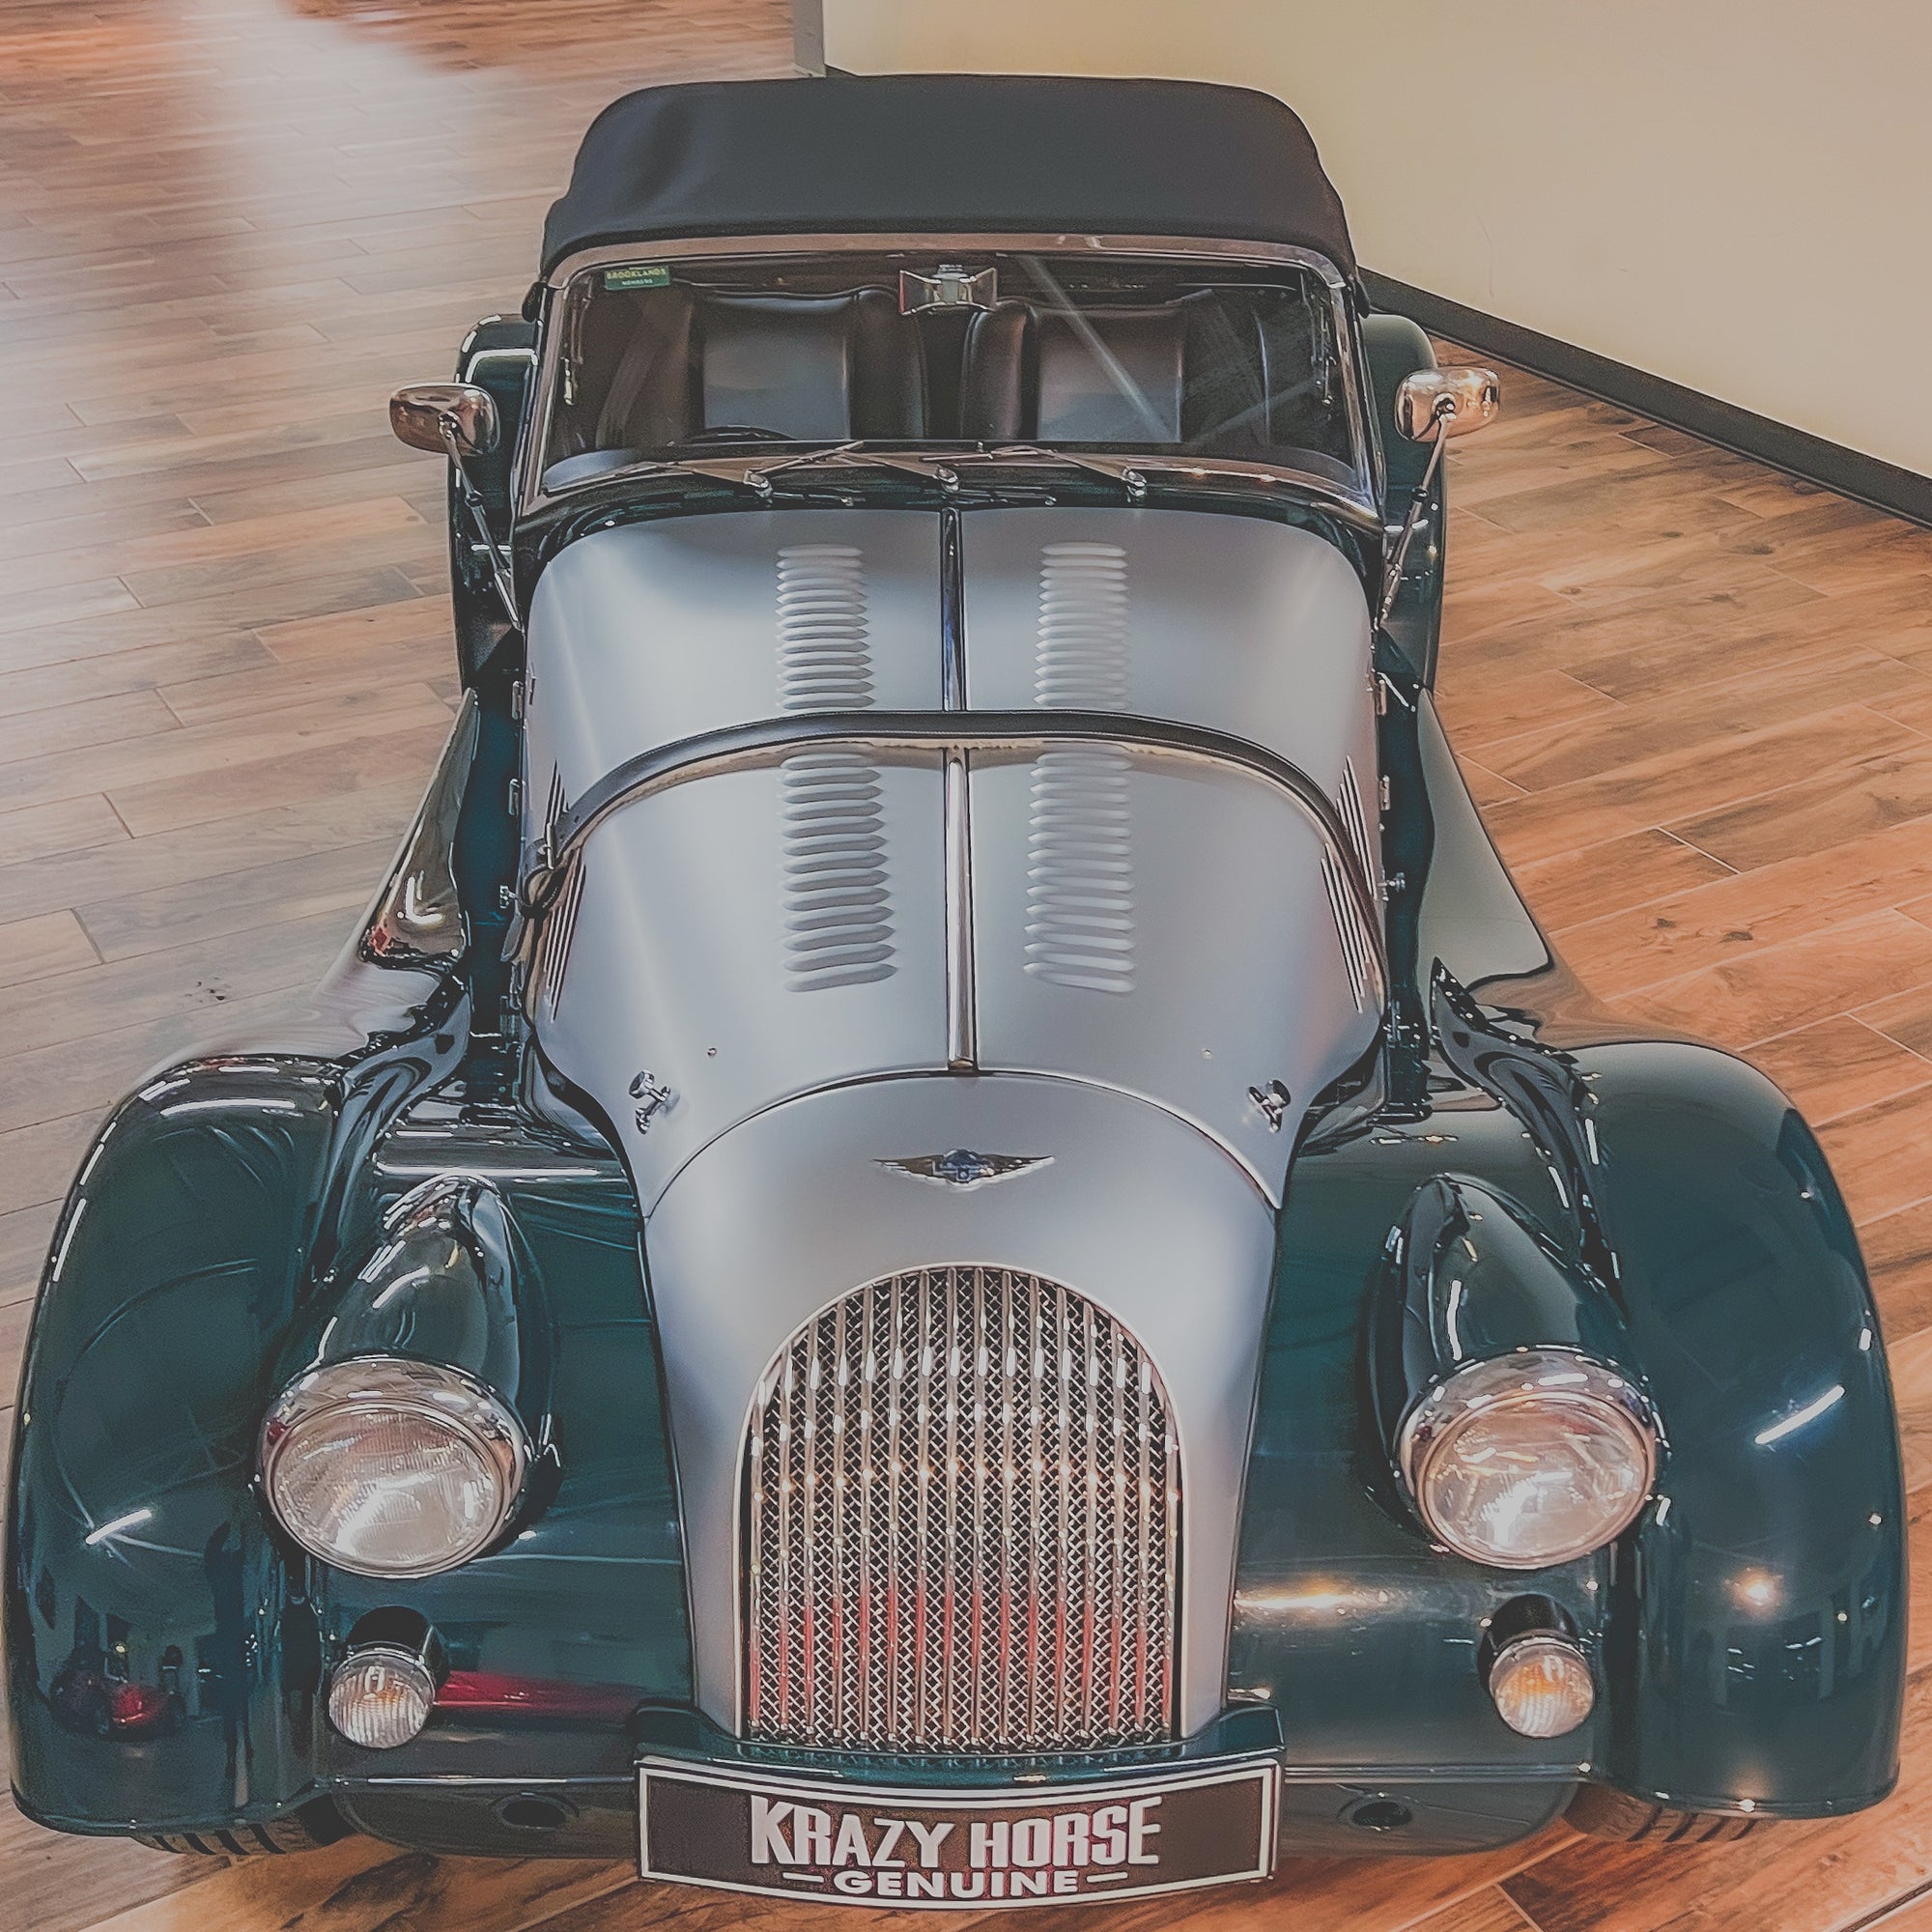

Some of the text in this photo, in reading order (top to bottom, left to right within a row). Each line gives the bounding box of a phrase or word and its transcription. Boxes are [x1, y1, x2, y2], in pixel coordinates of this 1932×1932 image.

[606, 268, 667, 279] BROOKLANDS
[750, 1794, 1163, 1869] KRAZY HORSE
[834, 1869, 1079, 1899] GENUINE
